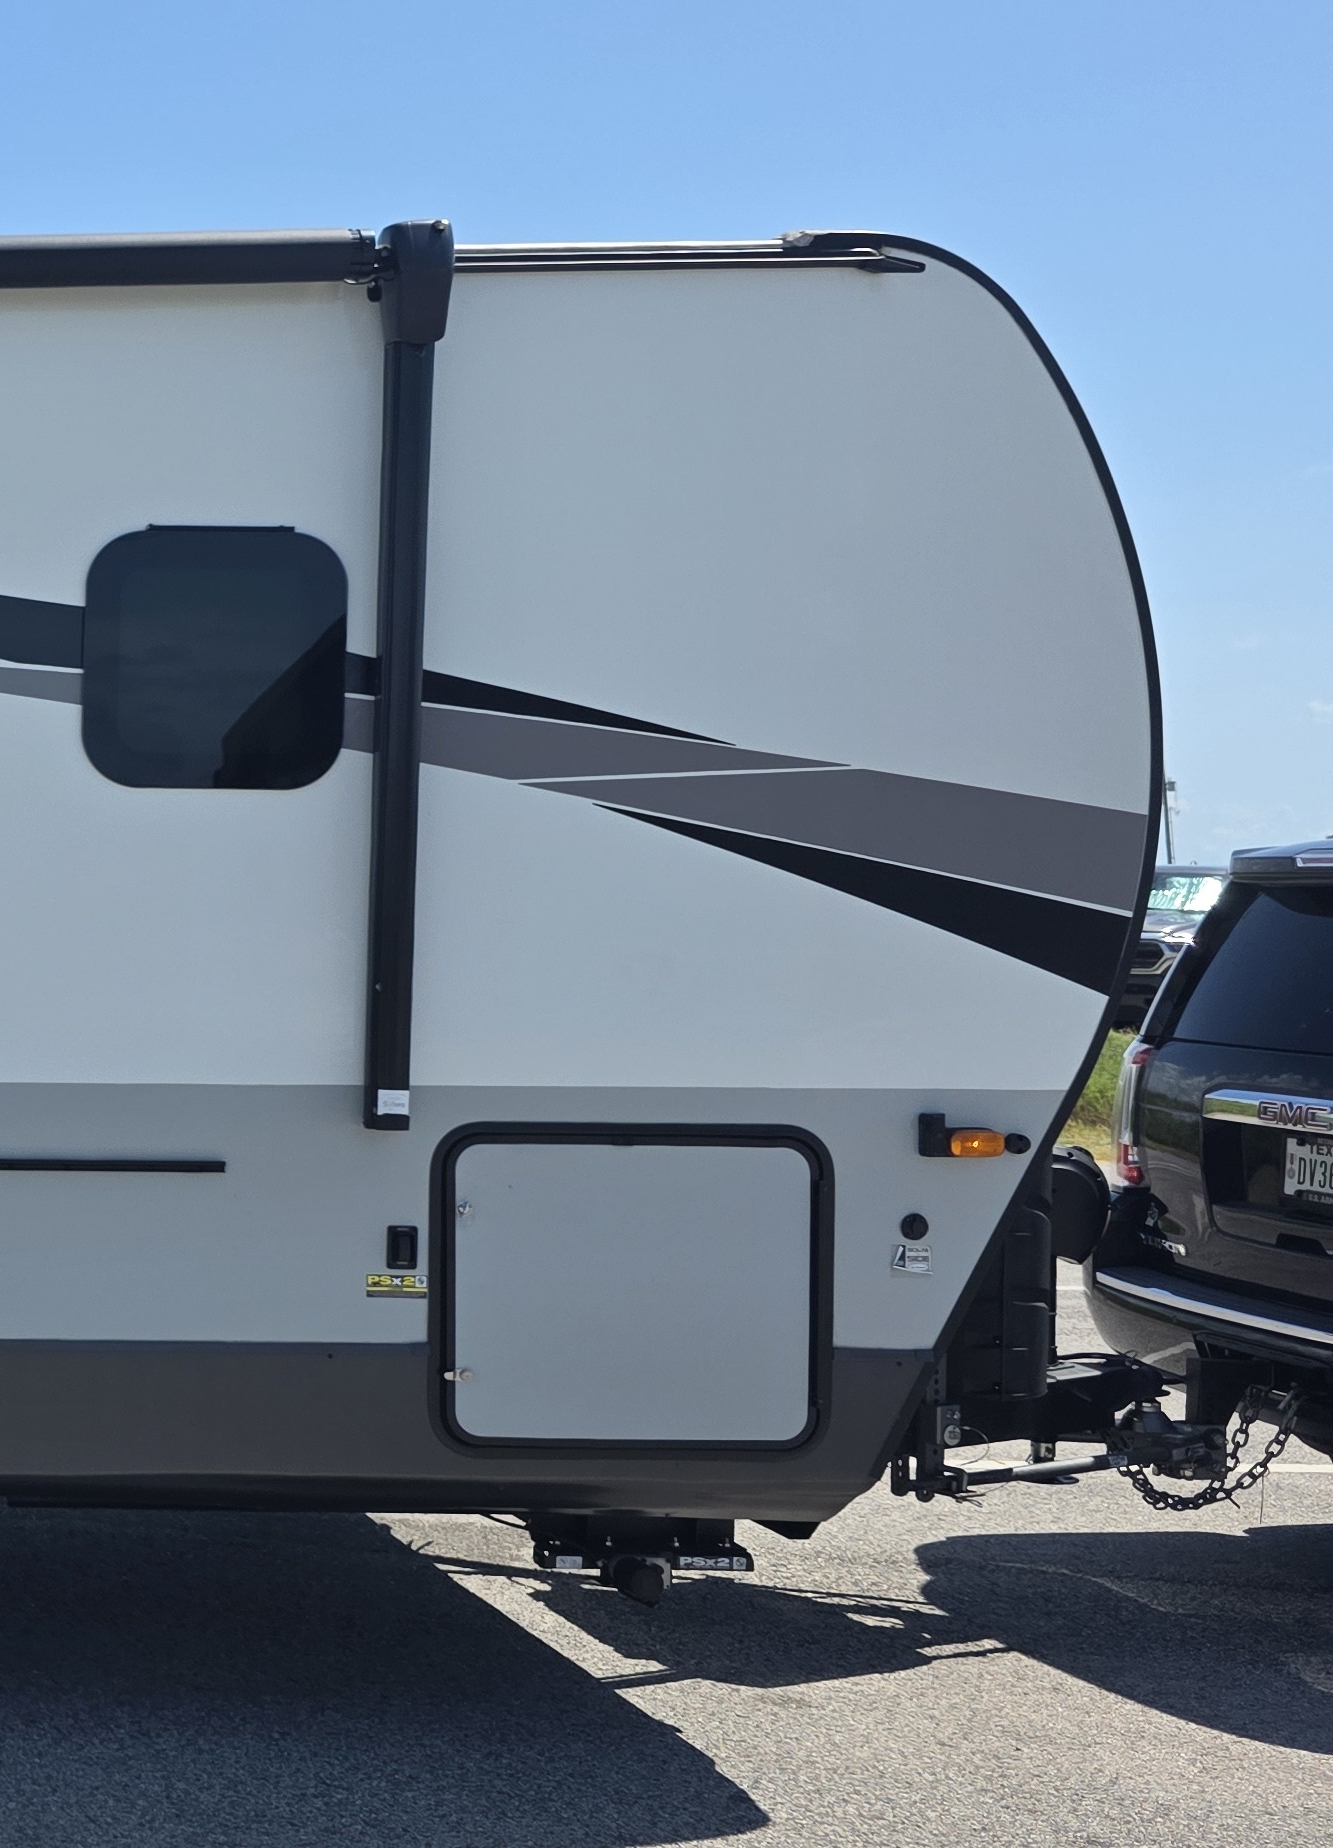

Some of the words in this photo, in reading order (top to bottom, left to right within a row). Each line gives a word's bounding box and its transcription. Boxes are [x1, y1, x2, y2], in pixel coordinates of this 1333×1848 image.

[1257, 1100, 1333, 1131] GMC
[367, 1275, 415, 1286] PSx2
[679, 1556, 730, 1568] PSx2
